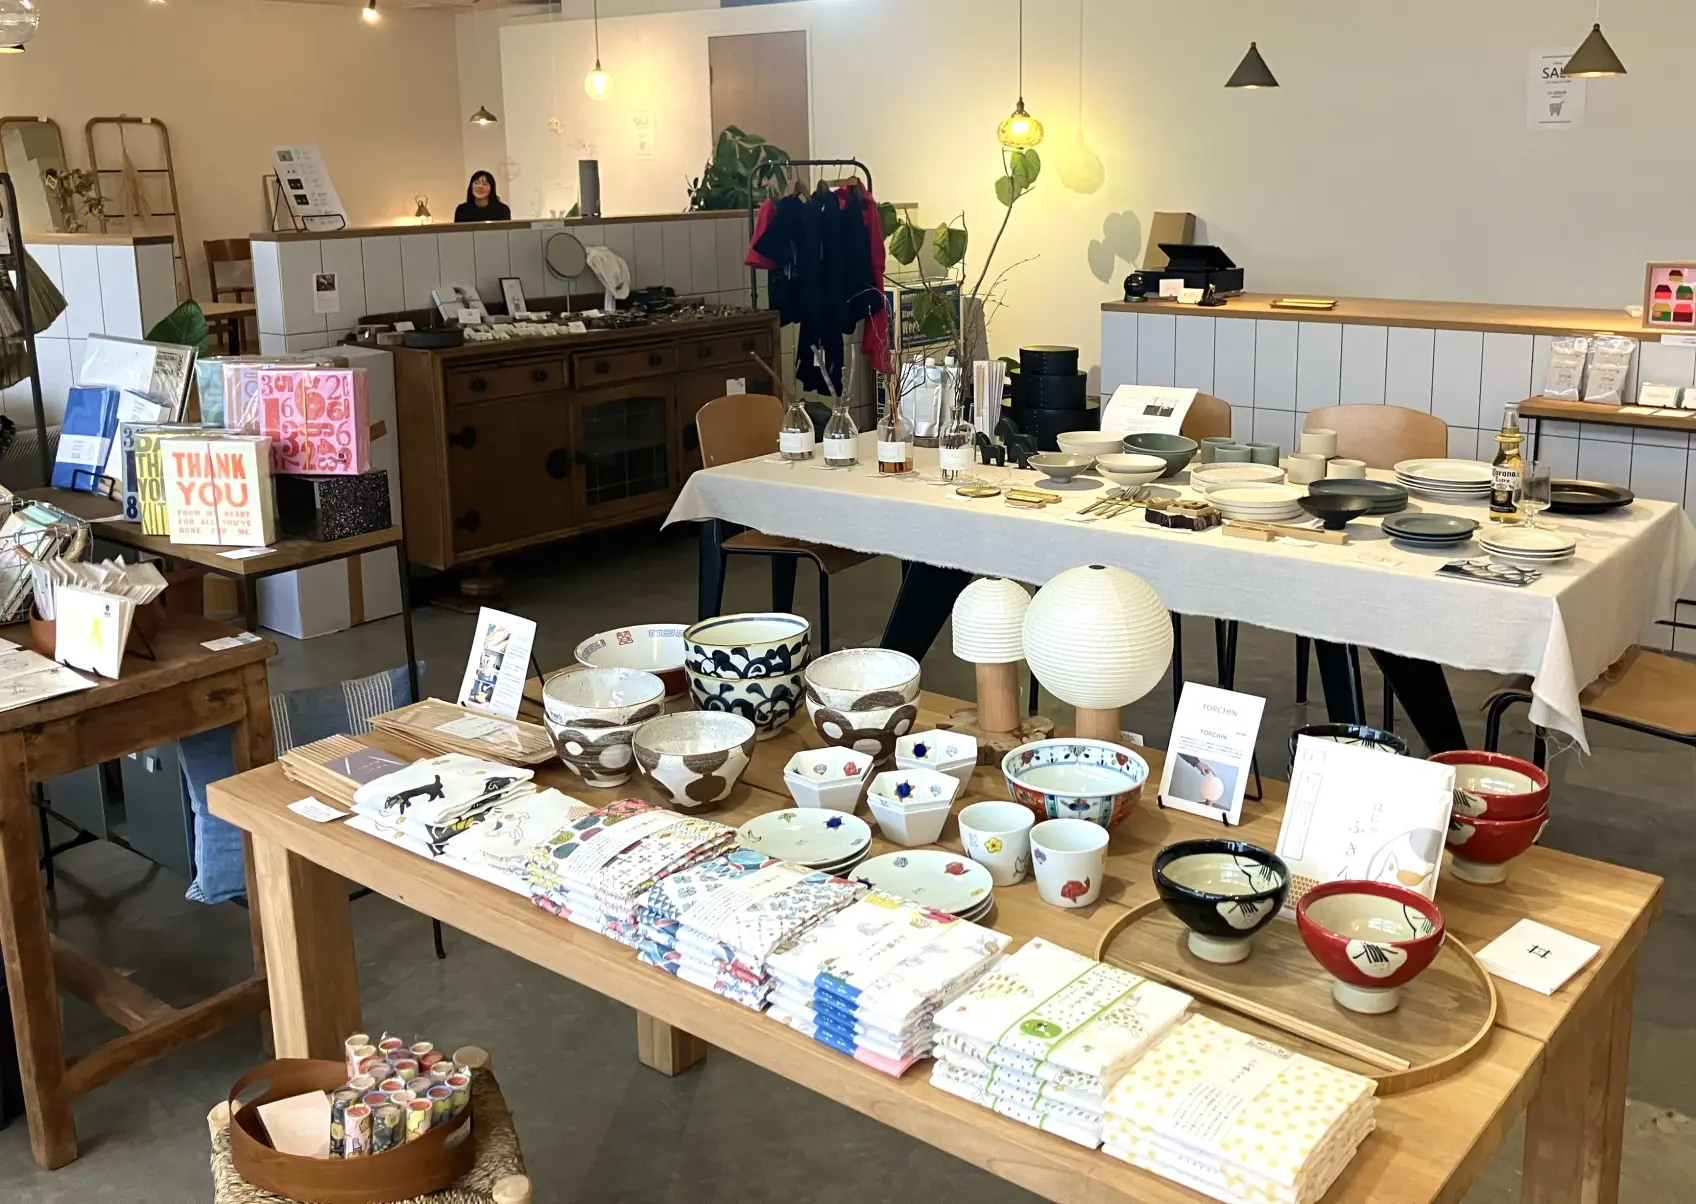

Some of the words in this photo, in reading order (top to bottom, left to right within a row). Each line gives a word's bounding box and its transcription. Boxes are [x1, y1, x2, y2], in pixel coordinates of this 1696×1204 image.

[1542, 67, 1571, 79] SAL
[172, 452, 246, 479] THANK
[176, 481, 248, 507] YOU
[224, 510, 250, 518] HEART
[1202, 703, 1238, 717] TORCHIN
[1200, 729, 1228, 740] TORCHIN
